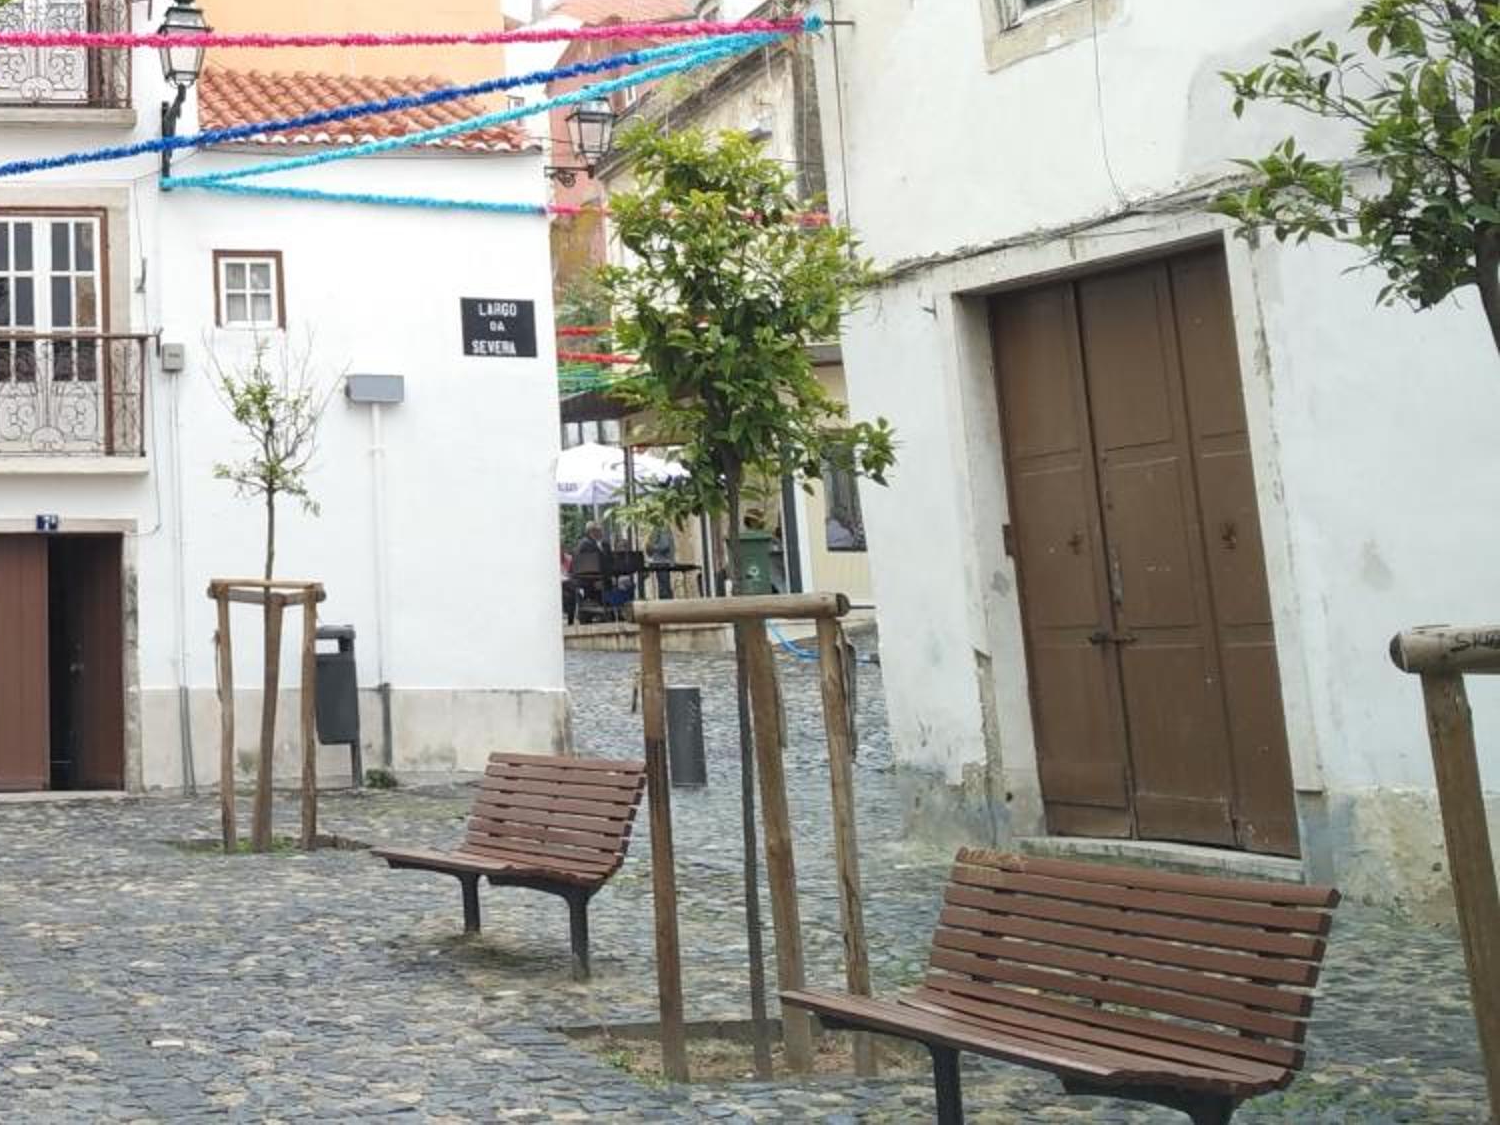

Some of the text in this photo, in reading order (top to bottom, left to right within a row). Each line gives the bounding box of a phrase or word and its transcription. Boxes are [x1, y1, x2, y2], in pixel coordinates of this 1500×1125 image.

[478, 302, 517, 317] LARGO
[489, 320, 505, 332] DA
[471, 339, 517, 355] SEVERA
